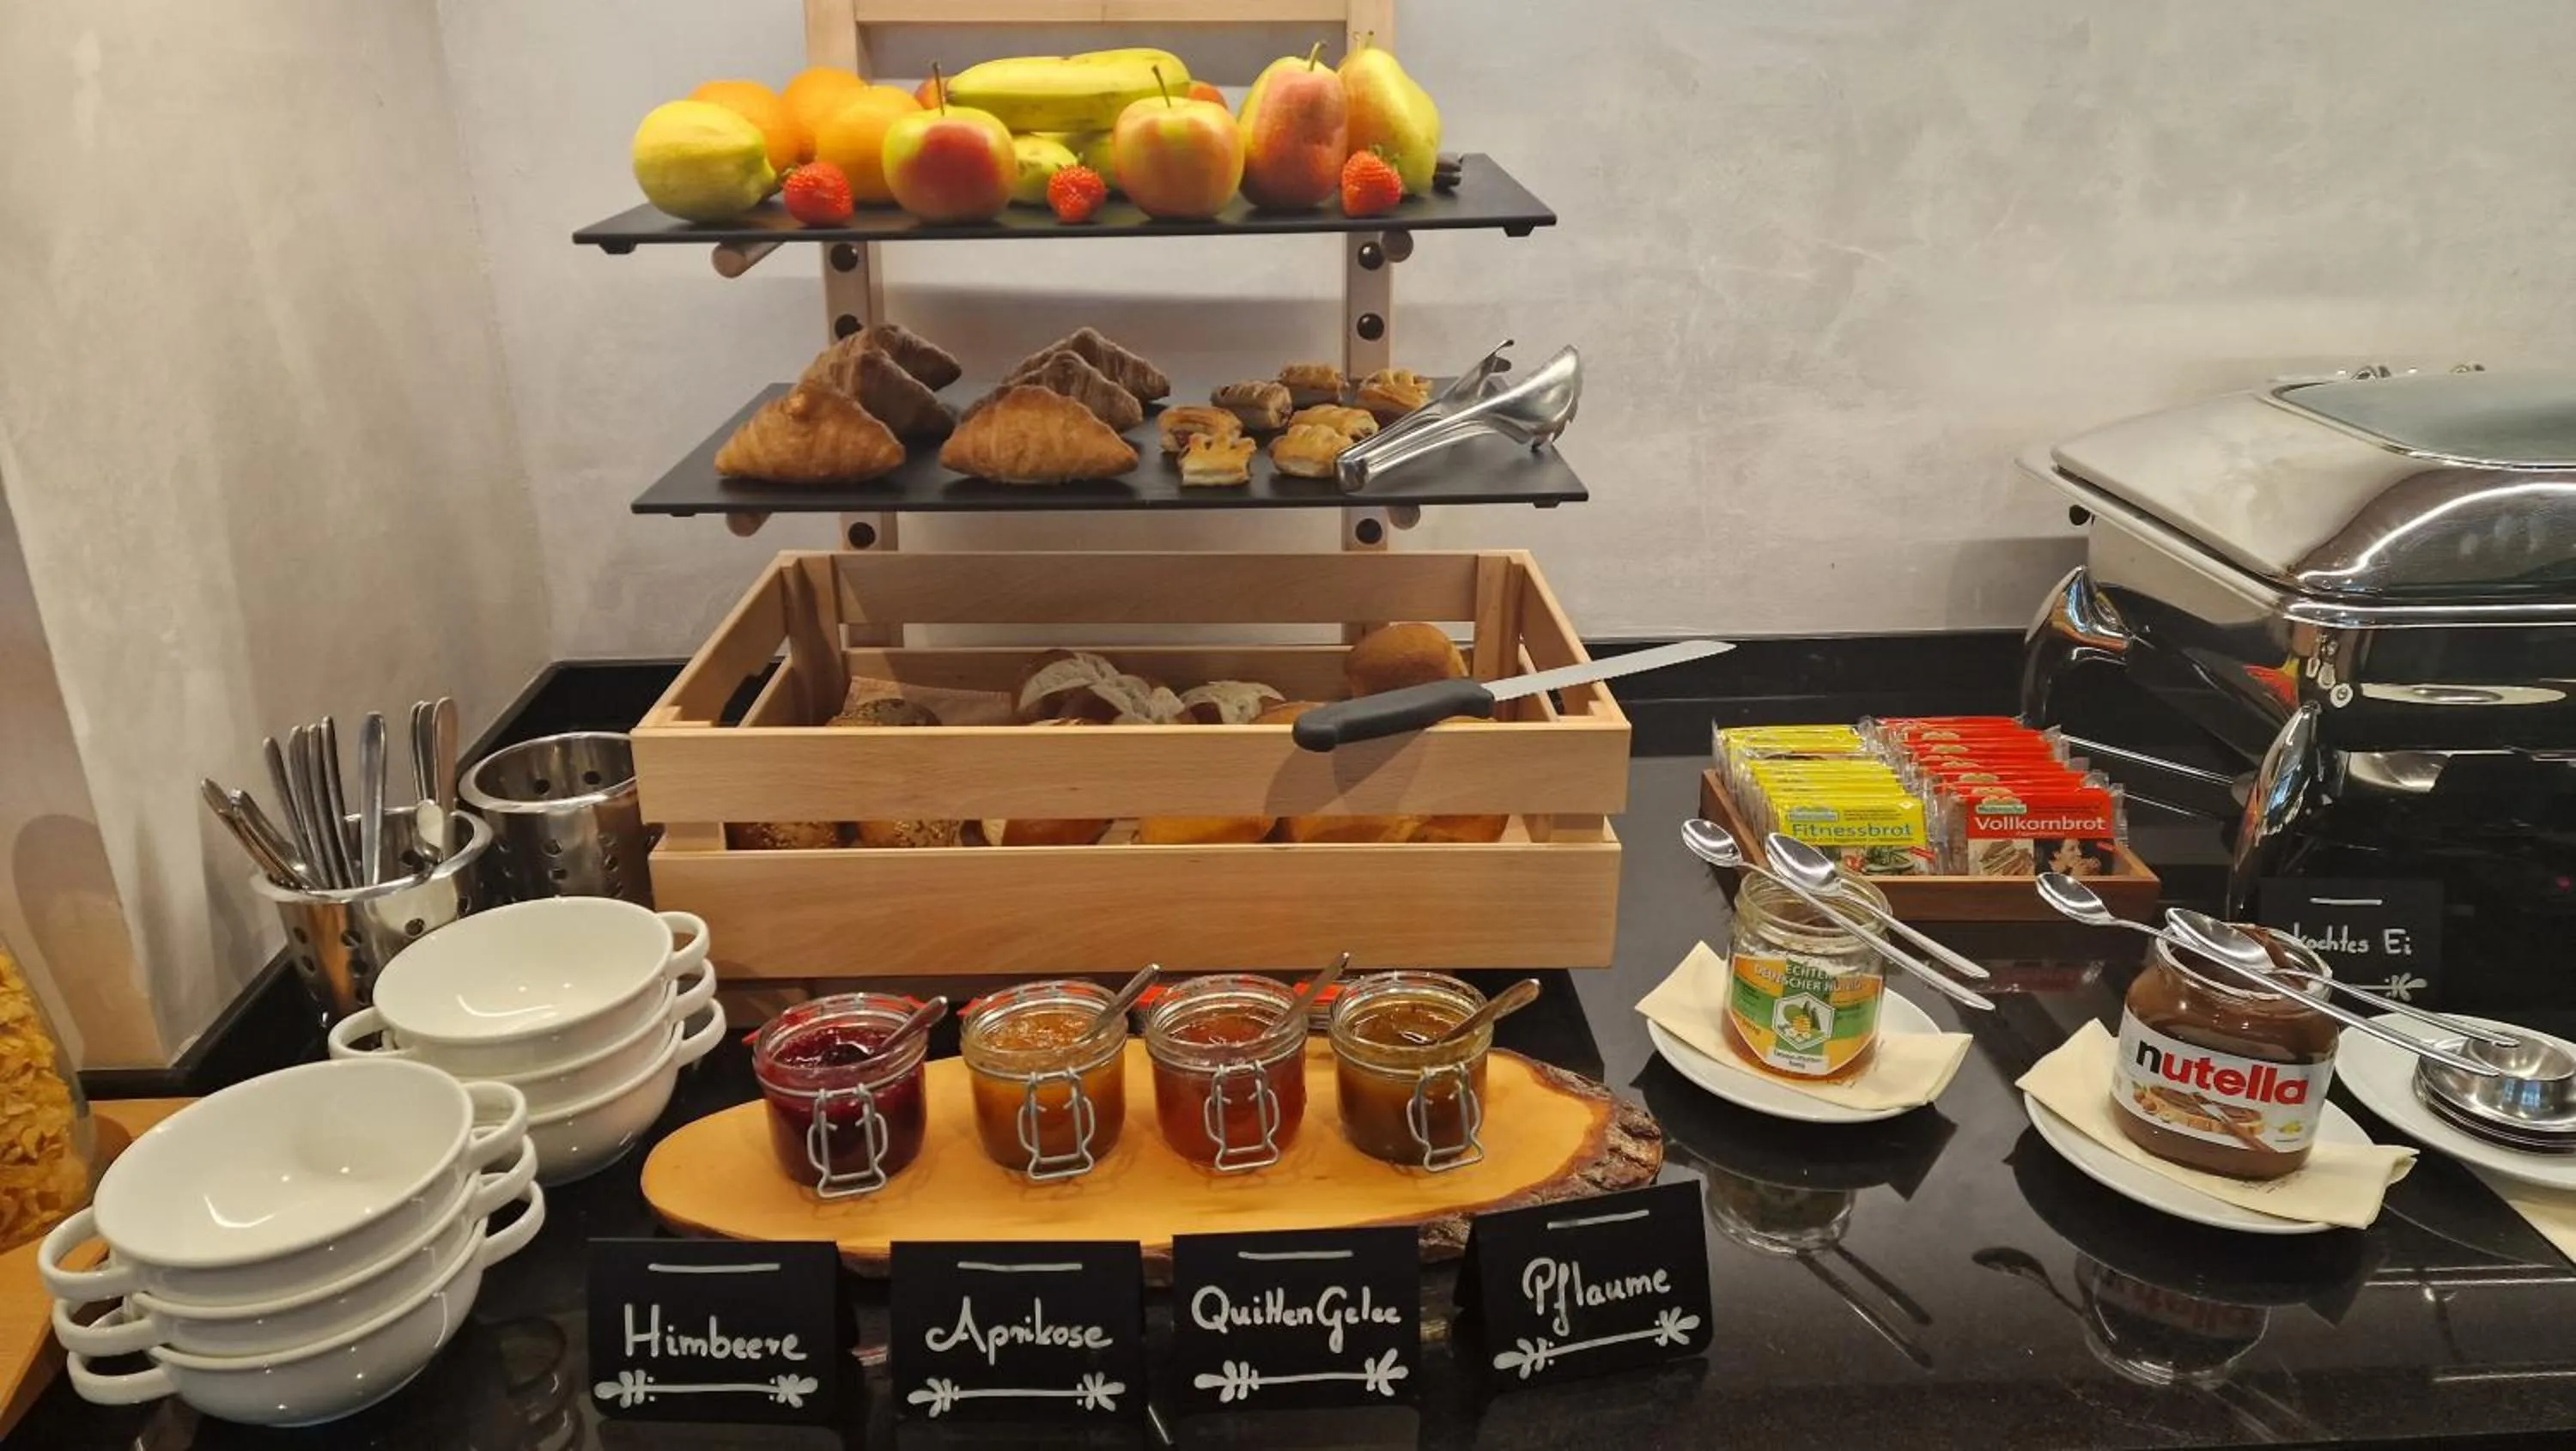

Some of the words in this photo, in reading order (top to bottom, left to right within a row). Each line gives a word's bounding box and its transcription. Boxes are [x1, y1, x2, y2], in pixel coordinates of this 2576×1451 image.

[1791, 823, 1911, 837] Fitnessbrot
[1975, 815, 2106, 831] Vollkornbrot
[2293, 921, 2370, 954] kochtes
[2383, 928, 2412, 956] Ei
[2136, 1040, 2310, 1104] nutella
[1522, 1257, 1672, 1336] Pflaume
[623, 1302, 809, 1361] Himbeere
[925, 1295, 1115, 1365] Aprikose
